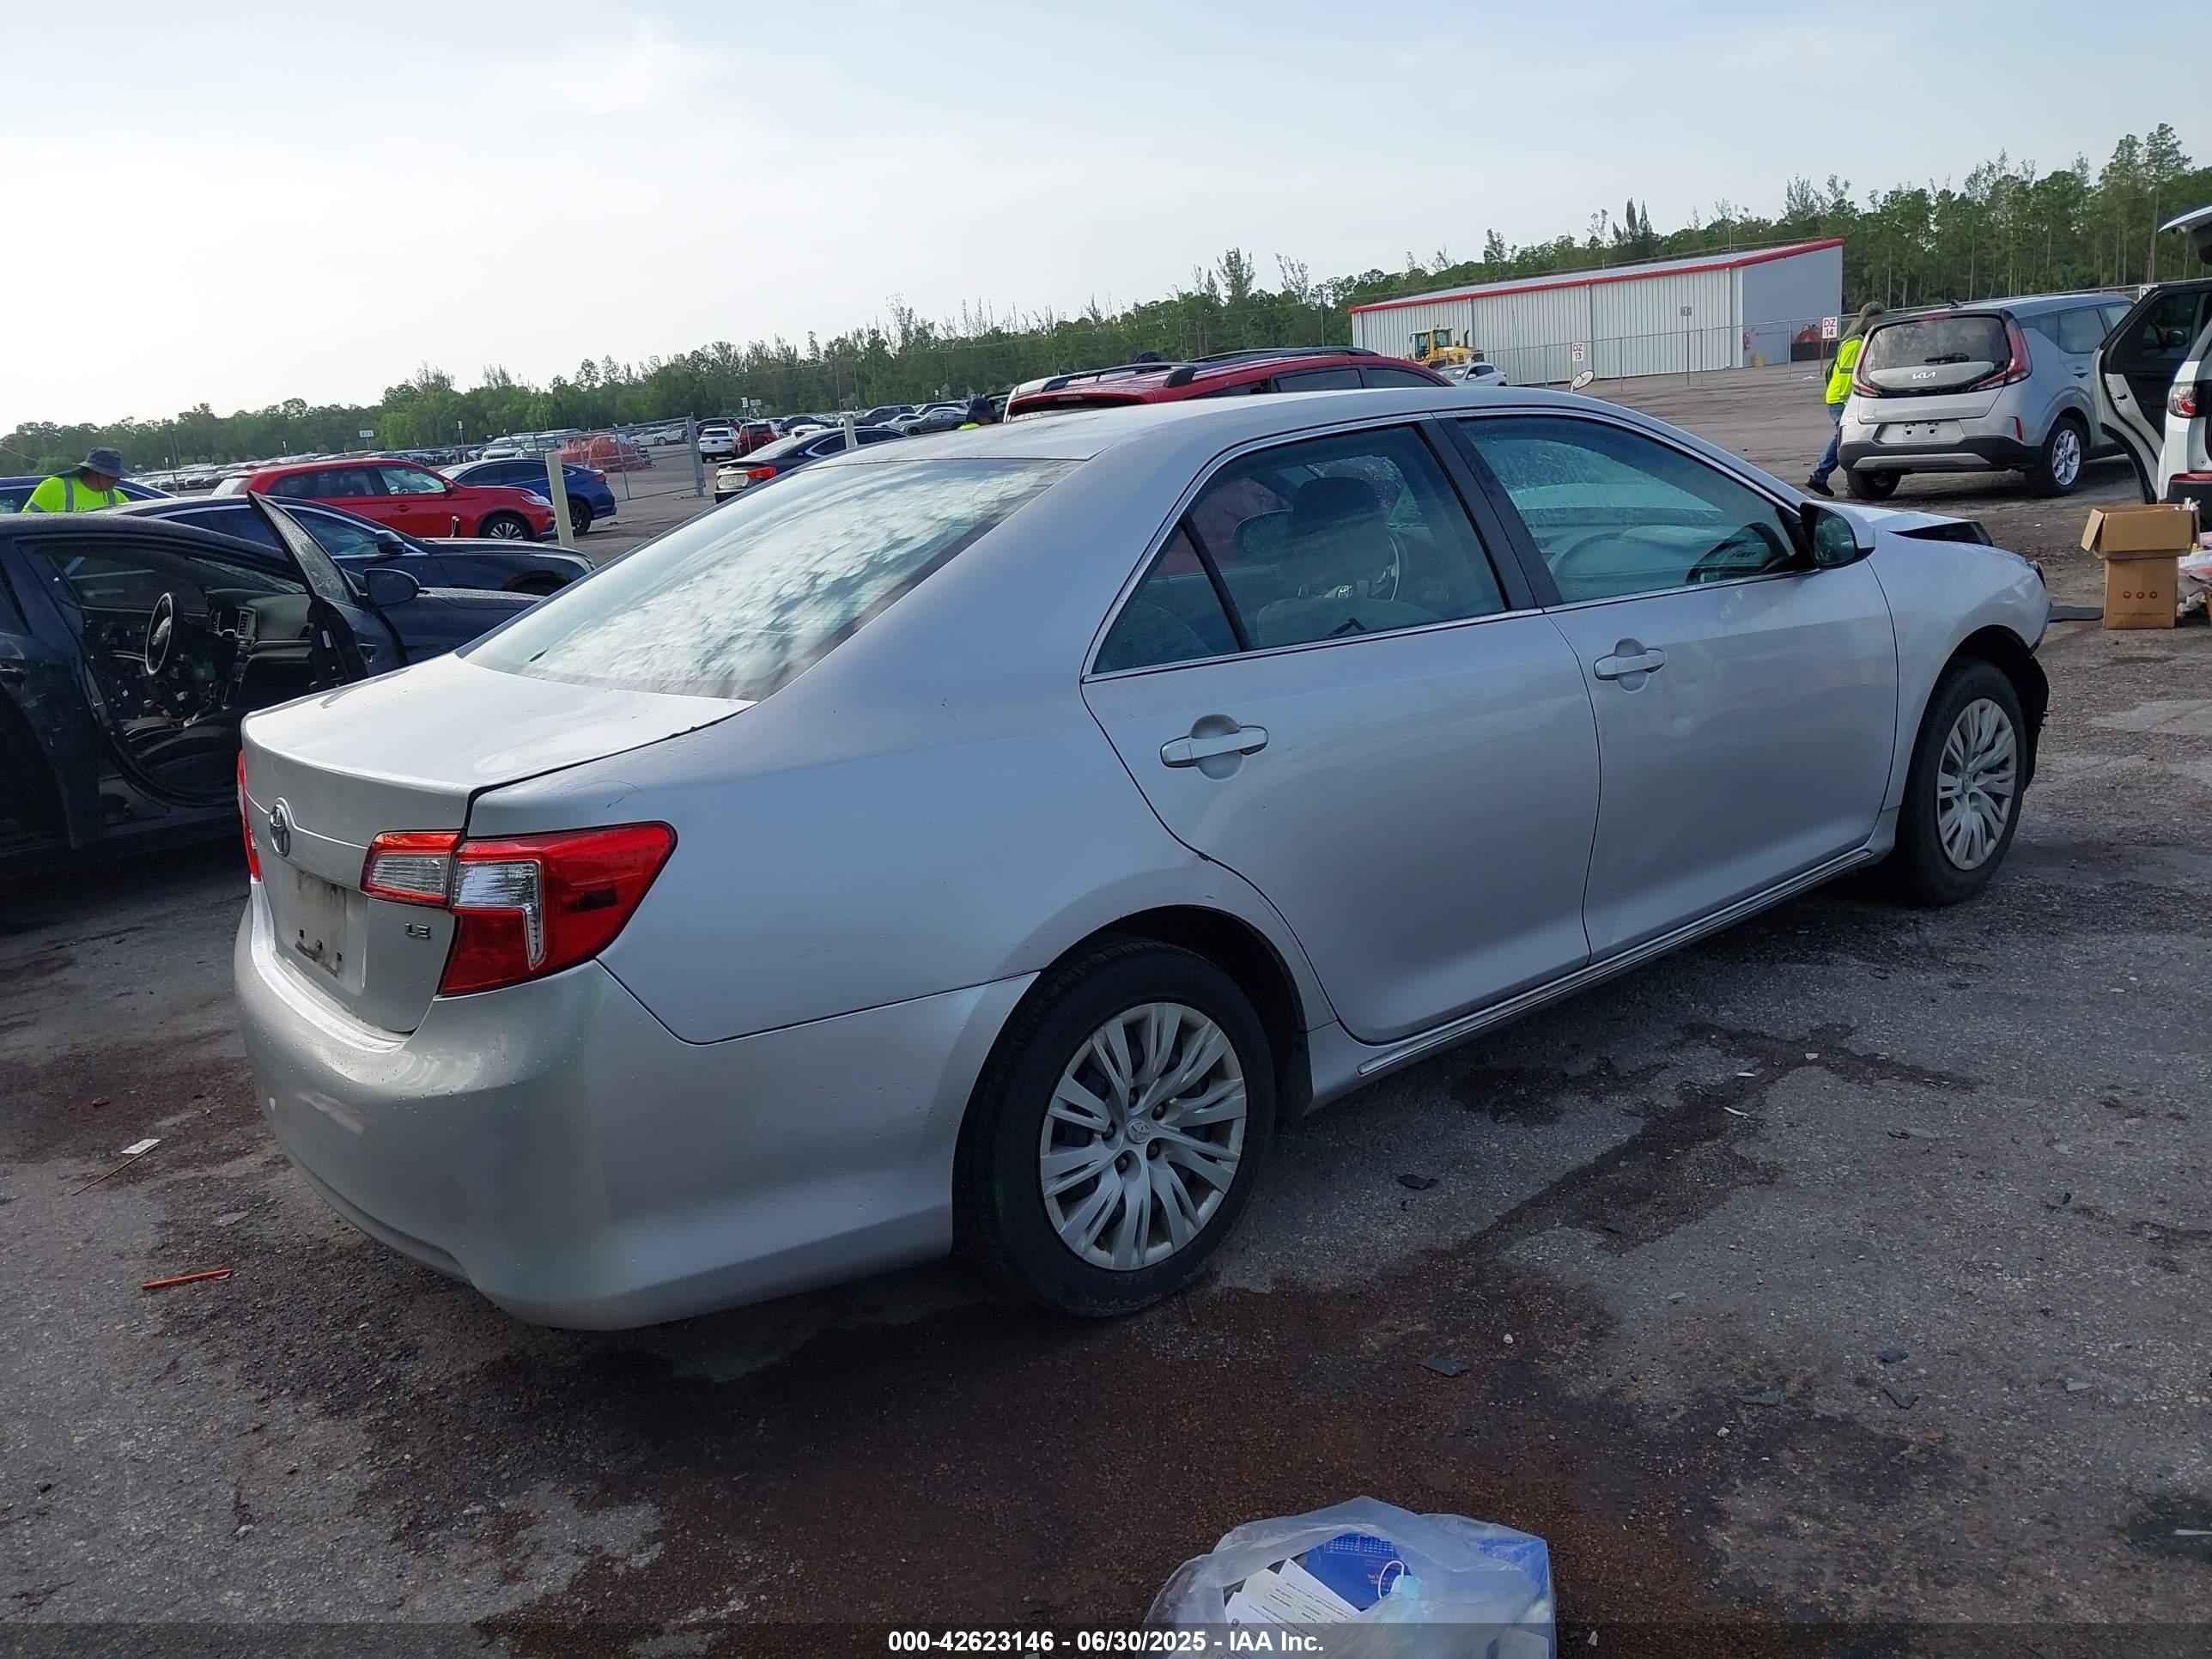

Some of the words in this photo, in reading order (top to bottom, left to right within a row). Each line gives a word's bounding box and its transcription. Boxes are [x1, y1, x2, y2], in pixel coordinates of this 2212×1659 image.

[1824, 319, 1836, 327] DZ
[1826, 328, 1834, 337] 14
[1572, 343, 1583, 352] DZ
[1912, 371, 1936, 380] KIA
[404, 922, 430, 939] LE
